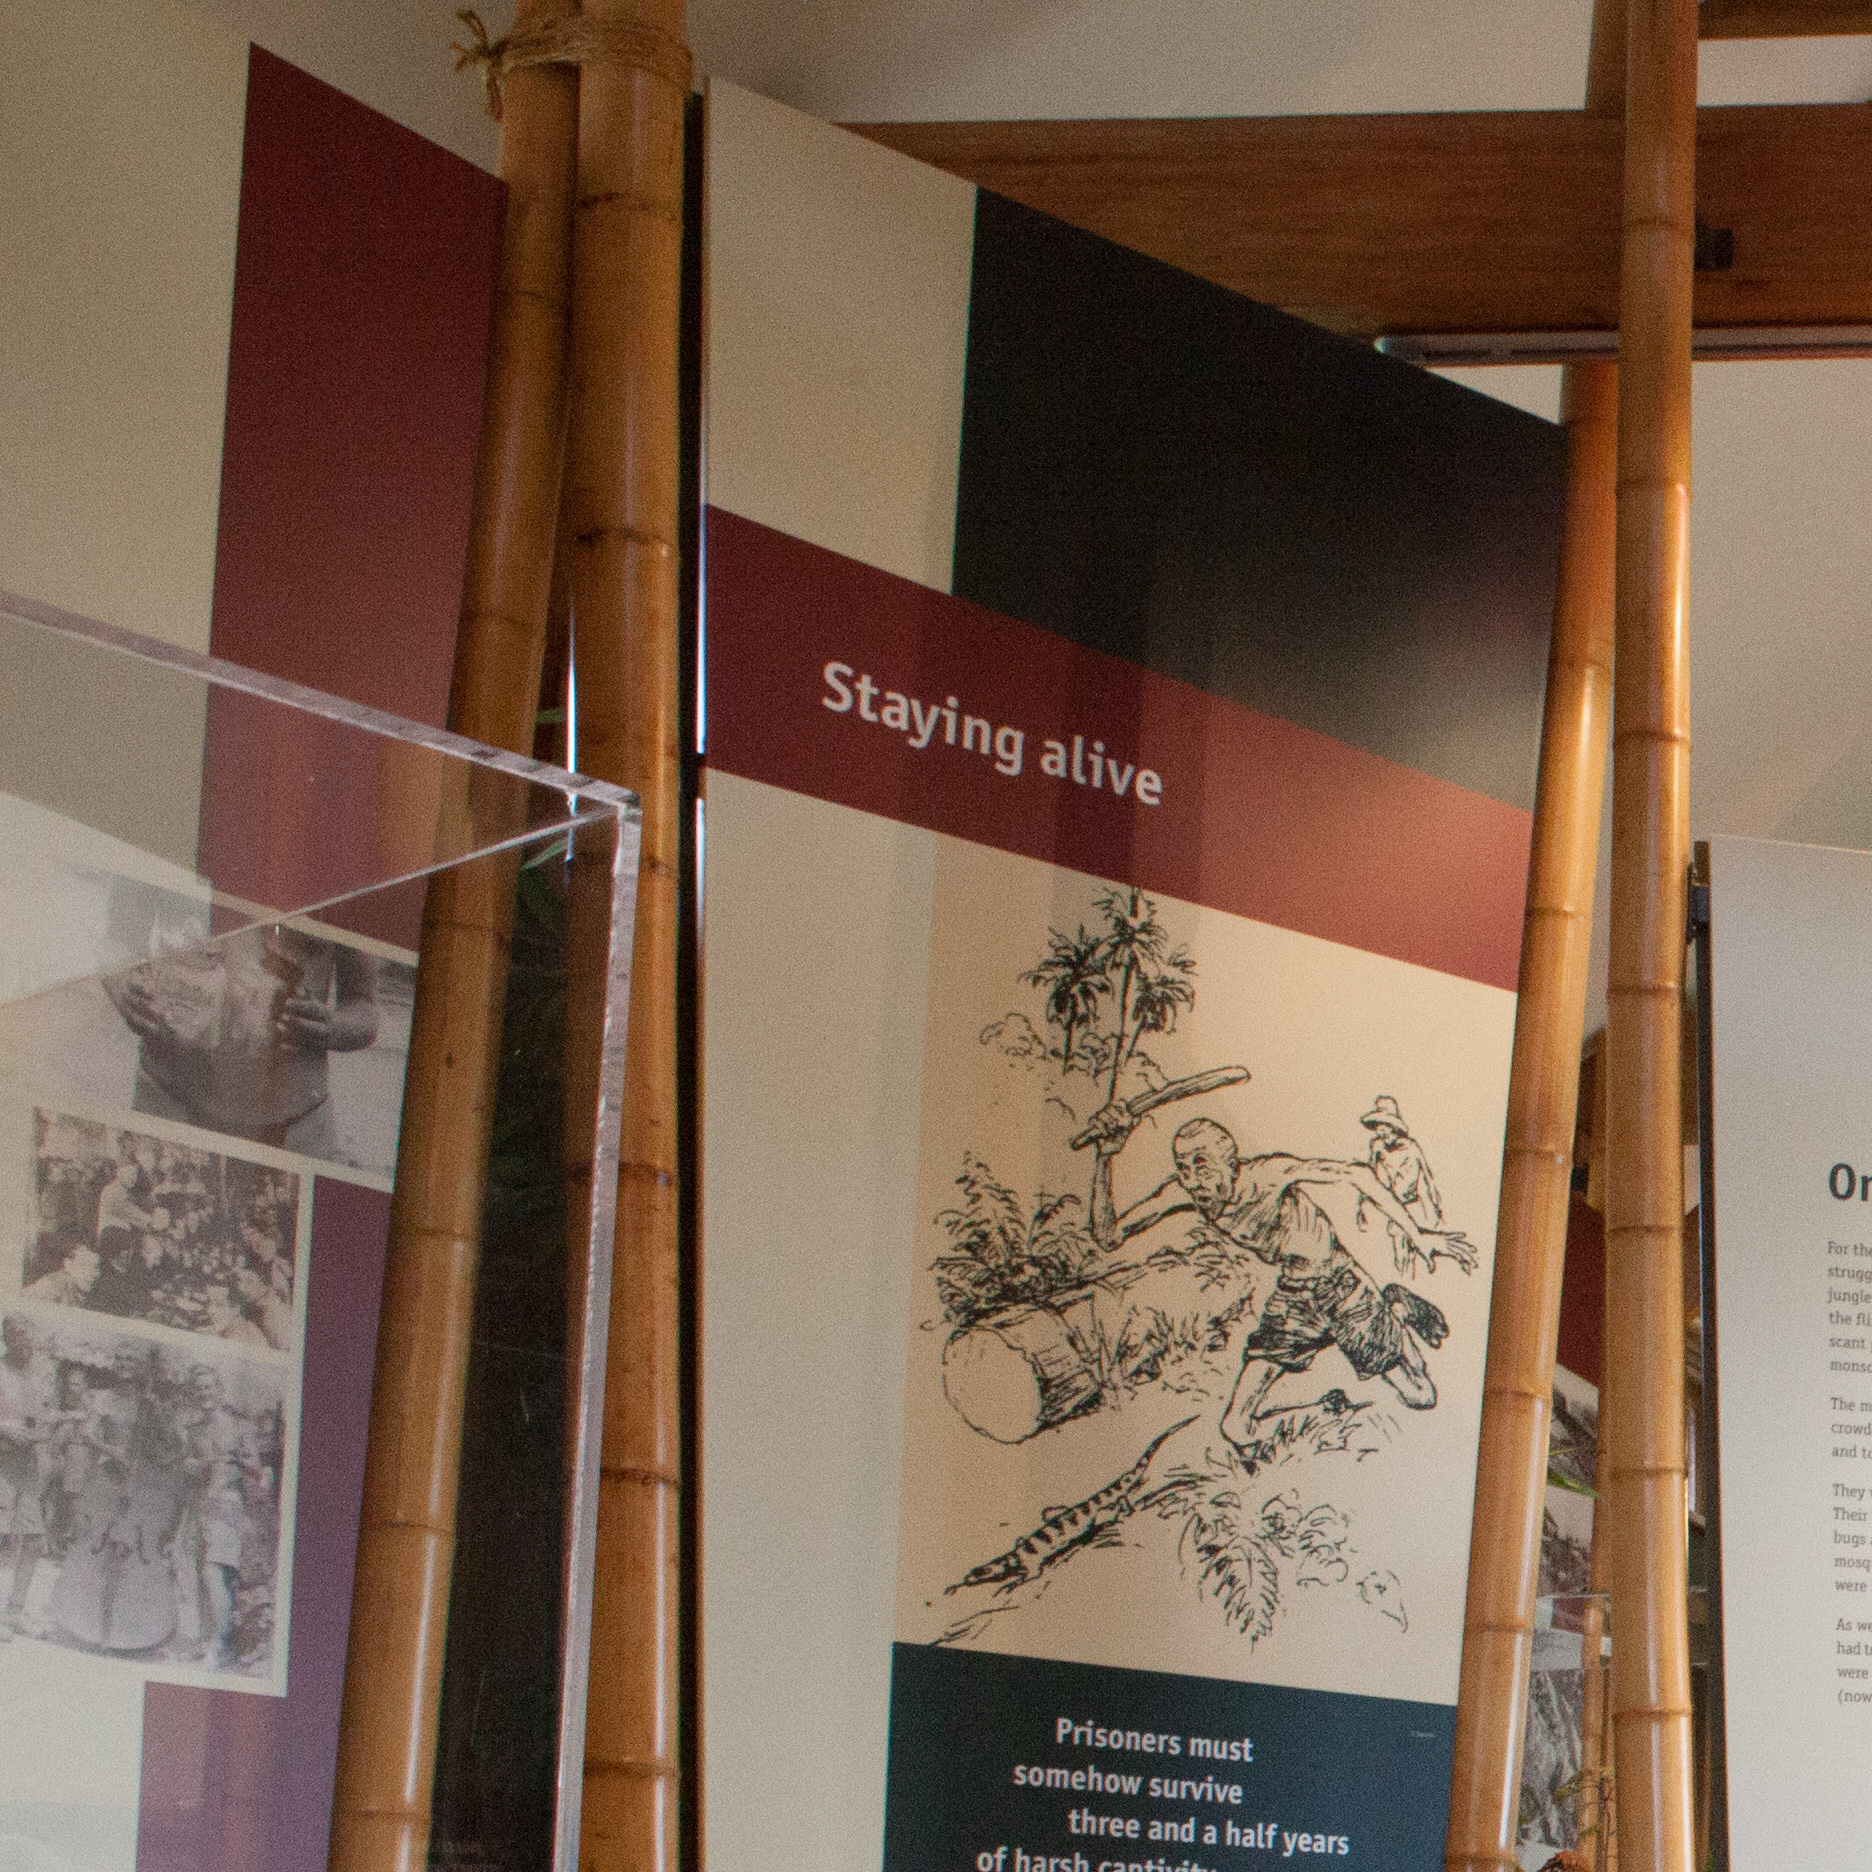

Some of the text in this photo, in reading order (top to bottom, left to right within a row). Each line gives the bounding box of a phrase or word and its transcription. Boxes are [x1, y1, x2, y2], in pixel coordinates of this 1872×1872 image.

[823, 661, 1162, 806] Staying alive
[1826, 1239, 1849, 1256] For
[1826, 1286, 1872, 1306] jungle
[1827, 1309, 1853, 1326] the
[1828, 1336, 1867, 1351] scant
[1056, 1717, 1253, 1763] Prisoners must
[1013, 1764, 1243, 1805] somehow survive
[1069, 1807, 1350, 1857] three and a half years
[976, 1845, 1006, 1872] of
